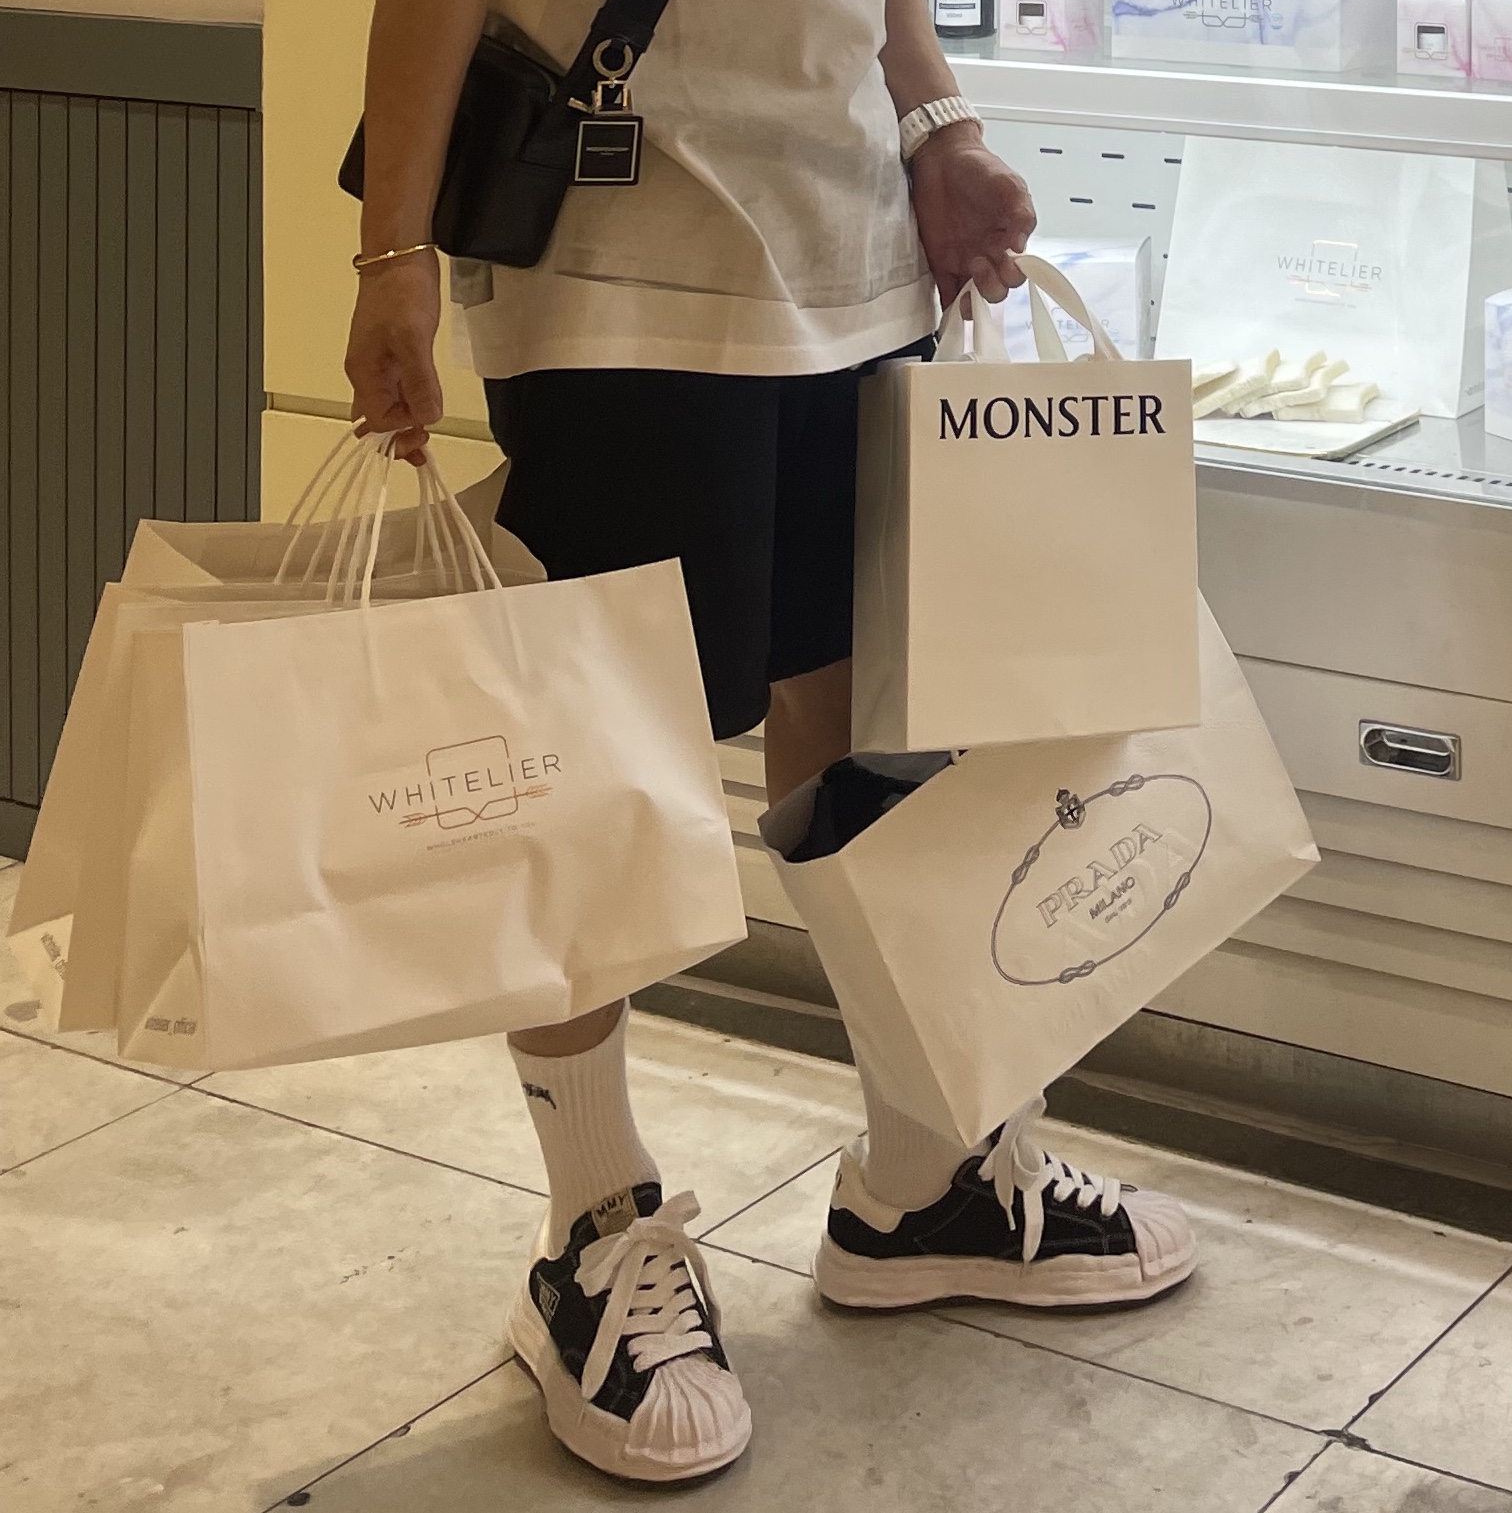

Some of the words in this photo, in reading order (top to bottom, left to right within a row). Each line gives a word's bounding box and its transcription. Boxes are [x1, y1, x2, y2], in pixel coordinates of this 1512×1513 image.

[1276, 255, 1383, 281] WHITELIER
[939, 394, 1168, 440] MONSTER
[367, 753, 562, 814] WHITELIER
[1035, 822, 1164, 929] PRADA
[1088, 875, 1136, 920] MILANO
